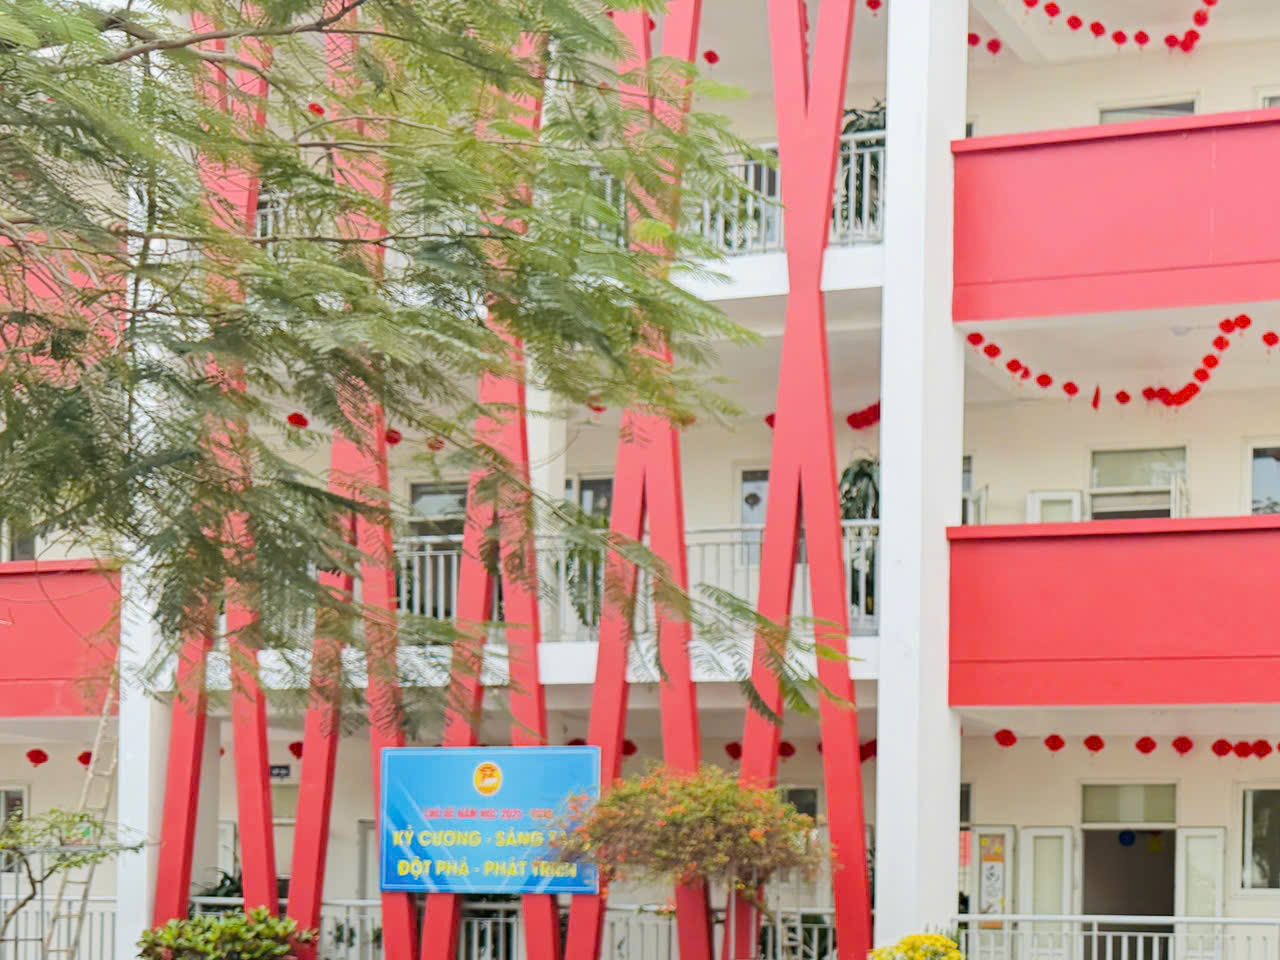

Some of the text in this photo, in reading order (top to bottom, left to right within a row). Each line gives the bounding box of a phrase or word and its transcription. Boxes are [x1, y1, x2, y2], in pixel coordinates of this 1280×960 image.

[495, 825, 544, 847] SÁNG
[397, 856, 432, 880] ĐỘT
[484, 856, 527, 877] PHÁT
